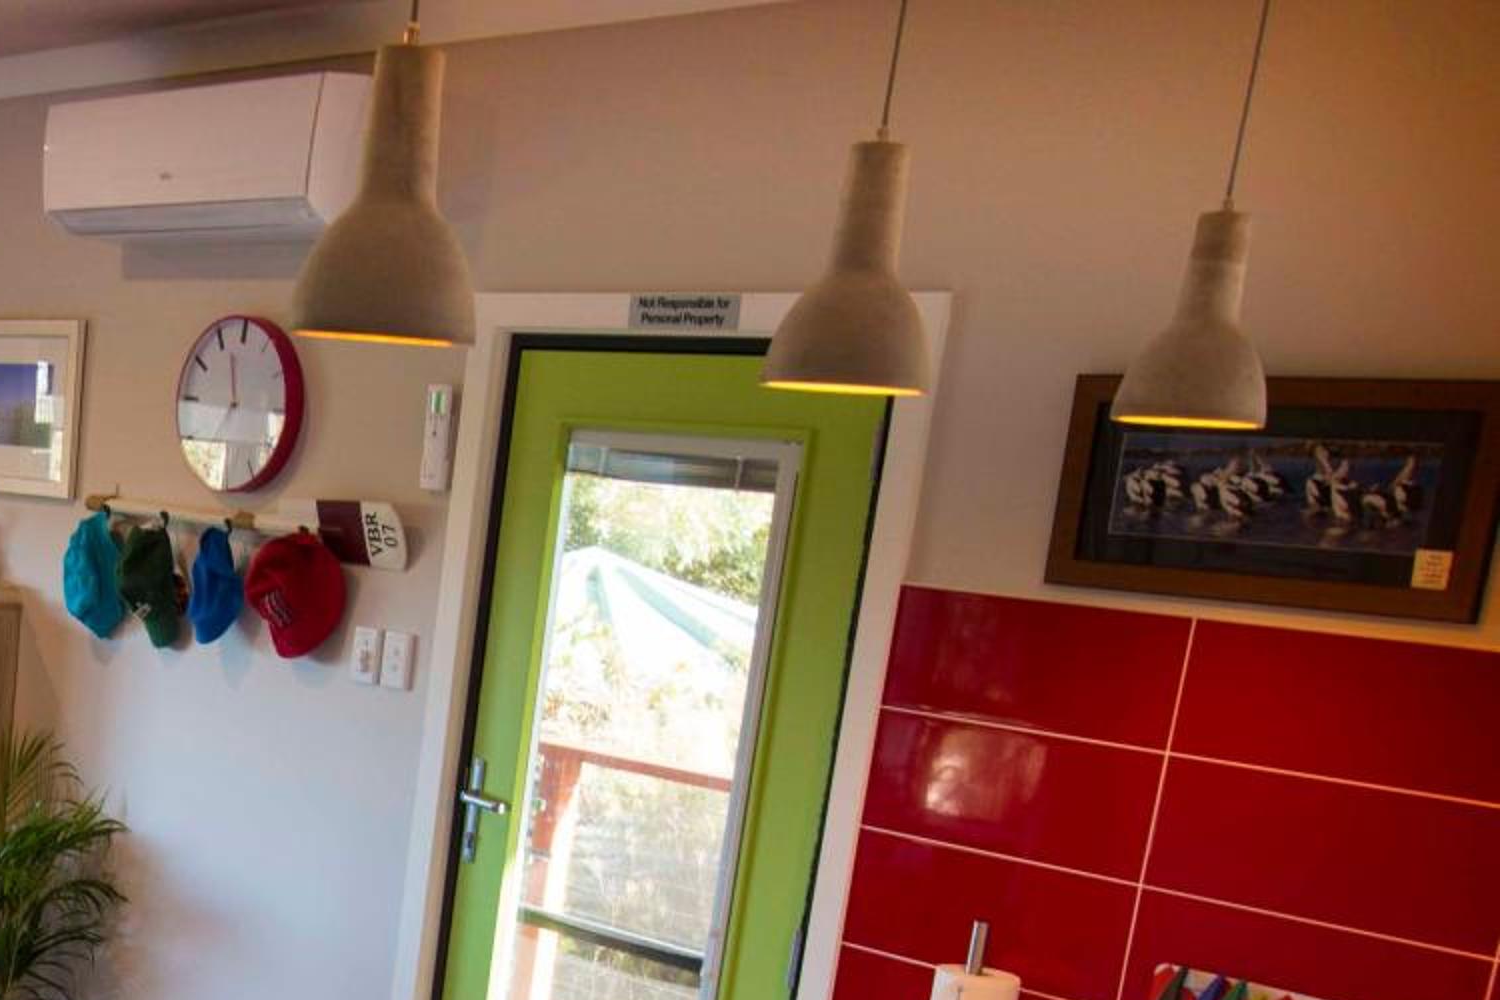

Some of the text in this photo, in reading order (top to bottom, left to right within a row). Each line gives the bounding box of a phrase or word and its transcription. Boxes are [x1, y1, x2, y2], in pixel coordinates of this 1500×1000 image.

[641, 312, 724, 328] Personal Property
[365, 512, 383, 556] VBR
[382, 525, 398, 547] 07
